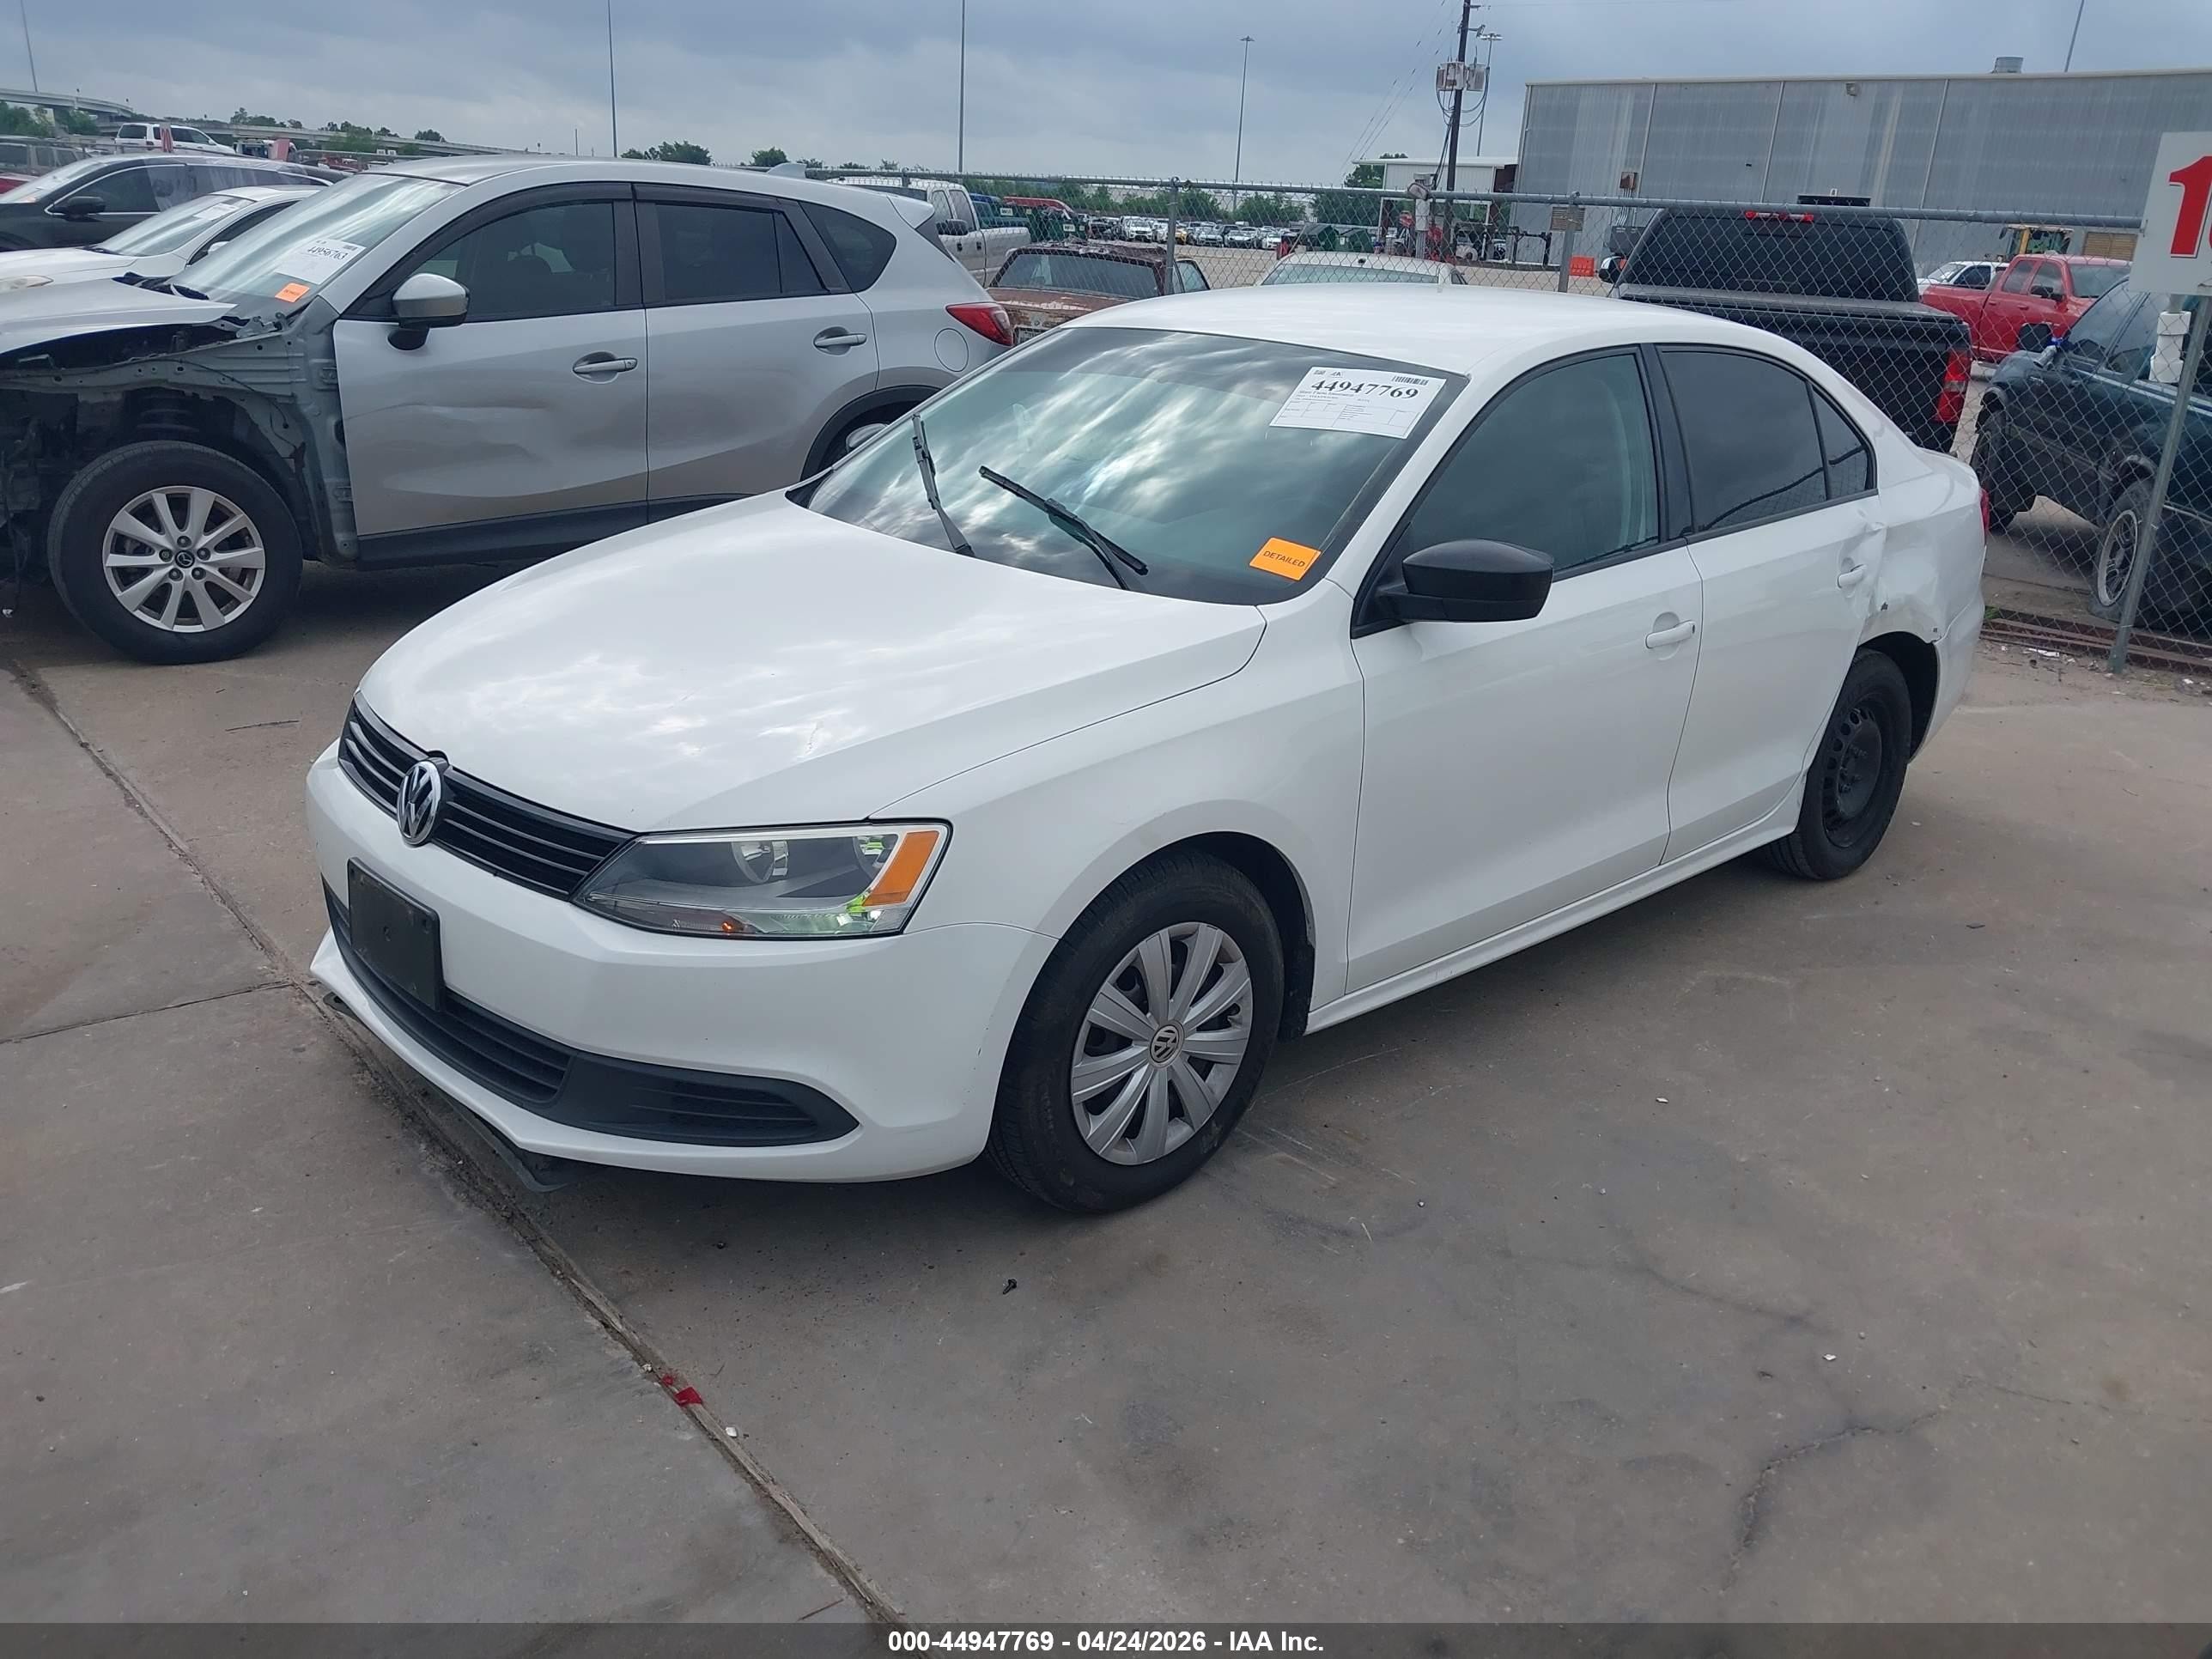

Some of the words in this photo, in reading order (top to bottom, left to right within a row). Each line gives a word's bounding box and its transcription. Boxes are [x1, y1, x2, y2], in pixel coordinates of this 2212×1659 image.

[2168, 155, 2212, 258] 1
[1311, 379, 1419, 399] 44947769
[1263, 550, 1306, 568] DETAILED
